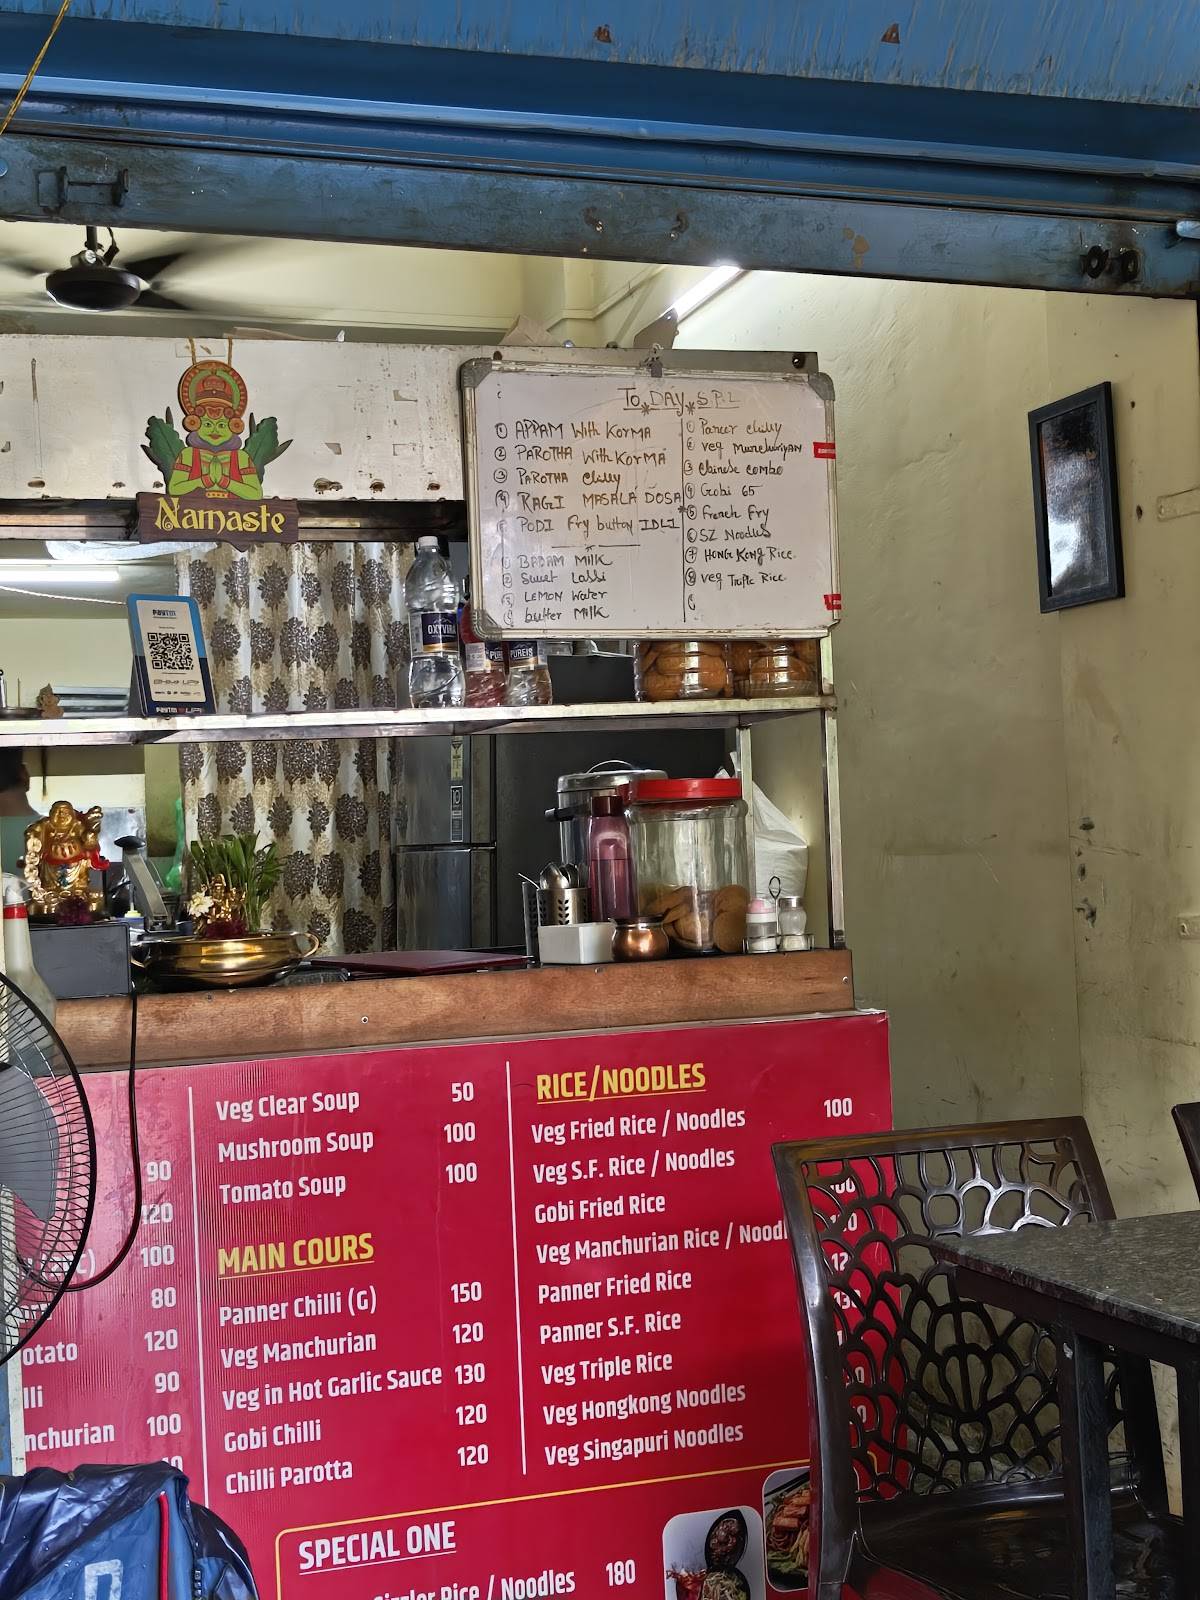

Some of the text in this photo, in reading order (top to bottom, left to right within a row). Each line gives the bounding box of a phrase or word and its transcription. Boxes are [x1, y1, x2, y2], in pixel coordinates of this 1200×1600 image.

[617, 387, 641, 407] To
[515, 418, 563, 440] APPAM
[514, 444, 573, 461] PAROTHA
[516, 467, 569, 485] PAROTHA
[742, 484, 763, 497] 65
[154, 497, 286, 535] Namaste
[517, 491, 566, 513] RAGI
[582, 491, 637, 509] MASALA
[645, 491, 682, 505] DOSA
[516, 516, 555, 533] PODI
[639, 518, 680, 531] IDLI
[518, 554, 565, 569] BADAM
[524, 591, 563, 603] LEMON
[537, 1063, 705, 1103] RICE/NOODLES
[216, 1082, 474, 1123] Veg Clear Soup 50
[532, 1098, 853, 1146] Veg Fried Rice / Noodles 100
[218, 1122, 476, 1163] Mushroom Soup 100
[146, 1160, 172, 1183] 90
[219, 1163, 478, 1205] Tomato Soup 100
[533, 1148, 735, 1186] Veg S.F. Rice / Noodles
[534, 1177, 856, 1224] Gobi Fried Rice 00
[141, 1244, 175, 1268] 100
[218, 1233, 374, 1278] MAIN COURS
[536, 1243, 571, 1266] Veg
[575, 1231, 678, 1260] Manchurian
[683, 1227, 720, 1249] Rice
[725, 1222, 733, 1250] /
[538, 1251, 850, 1305] Panner Fried Rice 12
[150, 1286, 177, 1309] 80
[219, 1281, 482, 1327] Panner Chilli (G) 150
[144, 1329, 178, 1353] 120
[220, 1322, 484, 1371] Veg Manchurian 120
[539, 1321, 604, 1345] Panner
[608, 1315, 640, 1337] S.F.
[645, 1310, 681, 1332] Rice
[154, 1370, 180, 1394] 90
[222, 1363, 486, 1412] Veg in Hot Garlic Sauce 130
[541, 1351, 673, 1386] Veg Triple Rice
[543, 1384, 746, 1427] Veg Hongkong Noodles
[146, 1413, 182, 1437] 100
[223, 1403, 487, 1453] Gobi Chilli 120
[544, 1423, 744, 1467] Veg Singapuri Noodles
[225, 1444, 489, 1495] Chilli Parotta 120
[298, 1521, 456, 1570] SPECIAL ONE
[500, 1569, 576, 1600] Noodles
[605, 1560, 636, 1587] 180
